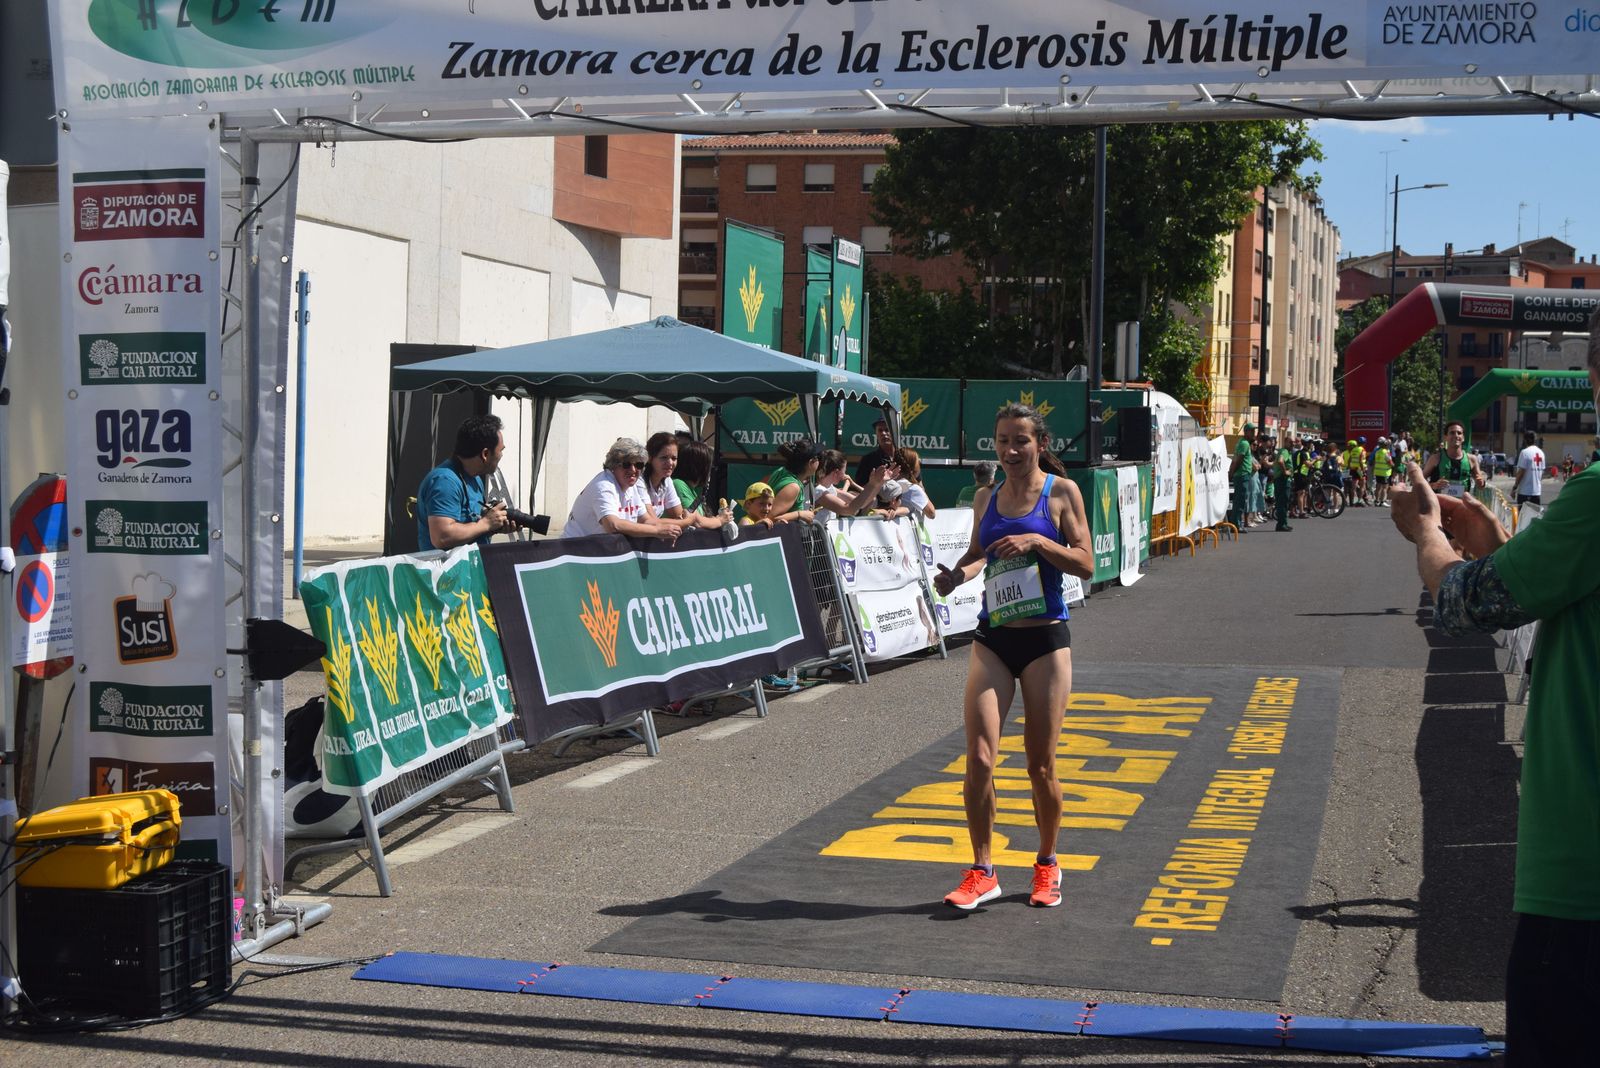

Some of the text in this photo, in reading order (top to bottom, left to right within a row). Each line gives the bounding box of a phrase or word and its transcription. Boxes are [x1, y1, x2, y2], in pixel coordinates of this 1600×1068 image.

[1384, 2, 1536, 22] AYUNTAMIENTO
[1383, 20, 1536, 44] DE ZAMORA
[441, 13, 1348, 79] Zamora cerca de la Esclerosis Múltiple
[83, 64, 416, 101] ASOCIACIÓN ZAMORANA DE ESCLEROSIS MÚLTIPLE
[103, 192, 197, 208] DIPUTACIÓN DE
[102, 207, 198, 229] ZAMORA
[124, 303, 159, 314] Zamora
[1524, 296, 1551, 307] CON
[1554, 297, 1569, 308] EL
[1472, 307, 1510, 316] ZAMORA
[1524, 311, 1584, 322] GANAMOS
[121, 351, 198, 365] FUNDACION
[121, 366, 198, 379] CAJA RURAL
[1541, 377, 1574, 389] CAJA
[1536, 400, 1596, 410] SALIDA
[95, 408, 192, 469] gaza
[732, 430, 768, 445] CAJA
[852, 433, 949, 449] CAJ RURAL
[98, 472, 192, 484] Ganaderos de Zamora
[125, 521, 200, 536] FUNDACION
[125, 536, 200, 549] CAJA RURAL
[995, 581, 1023, 607] MARÍA
[1001, 602, 1042, 618] CAJA RURAL
[627, 583, 768, 656] CAJA RURAL
[121, 613, 168, 647] Susi
[125, 703, 204, 718] FUNDACION
[125, 717, 205, 731] CAJA RURAL
[1187, 767, 1276, 831] INTEGRAL
[1133, 837, 1251, 931] REFORMA
